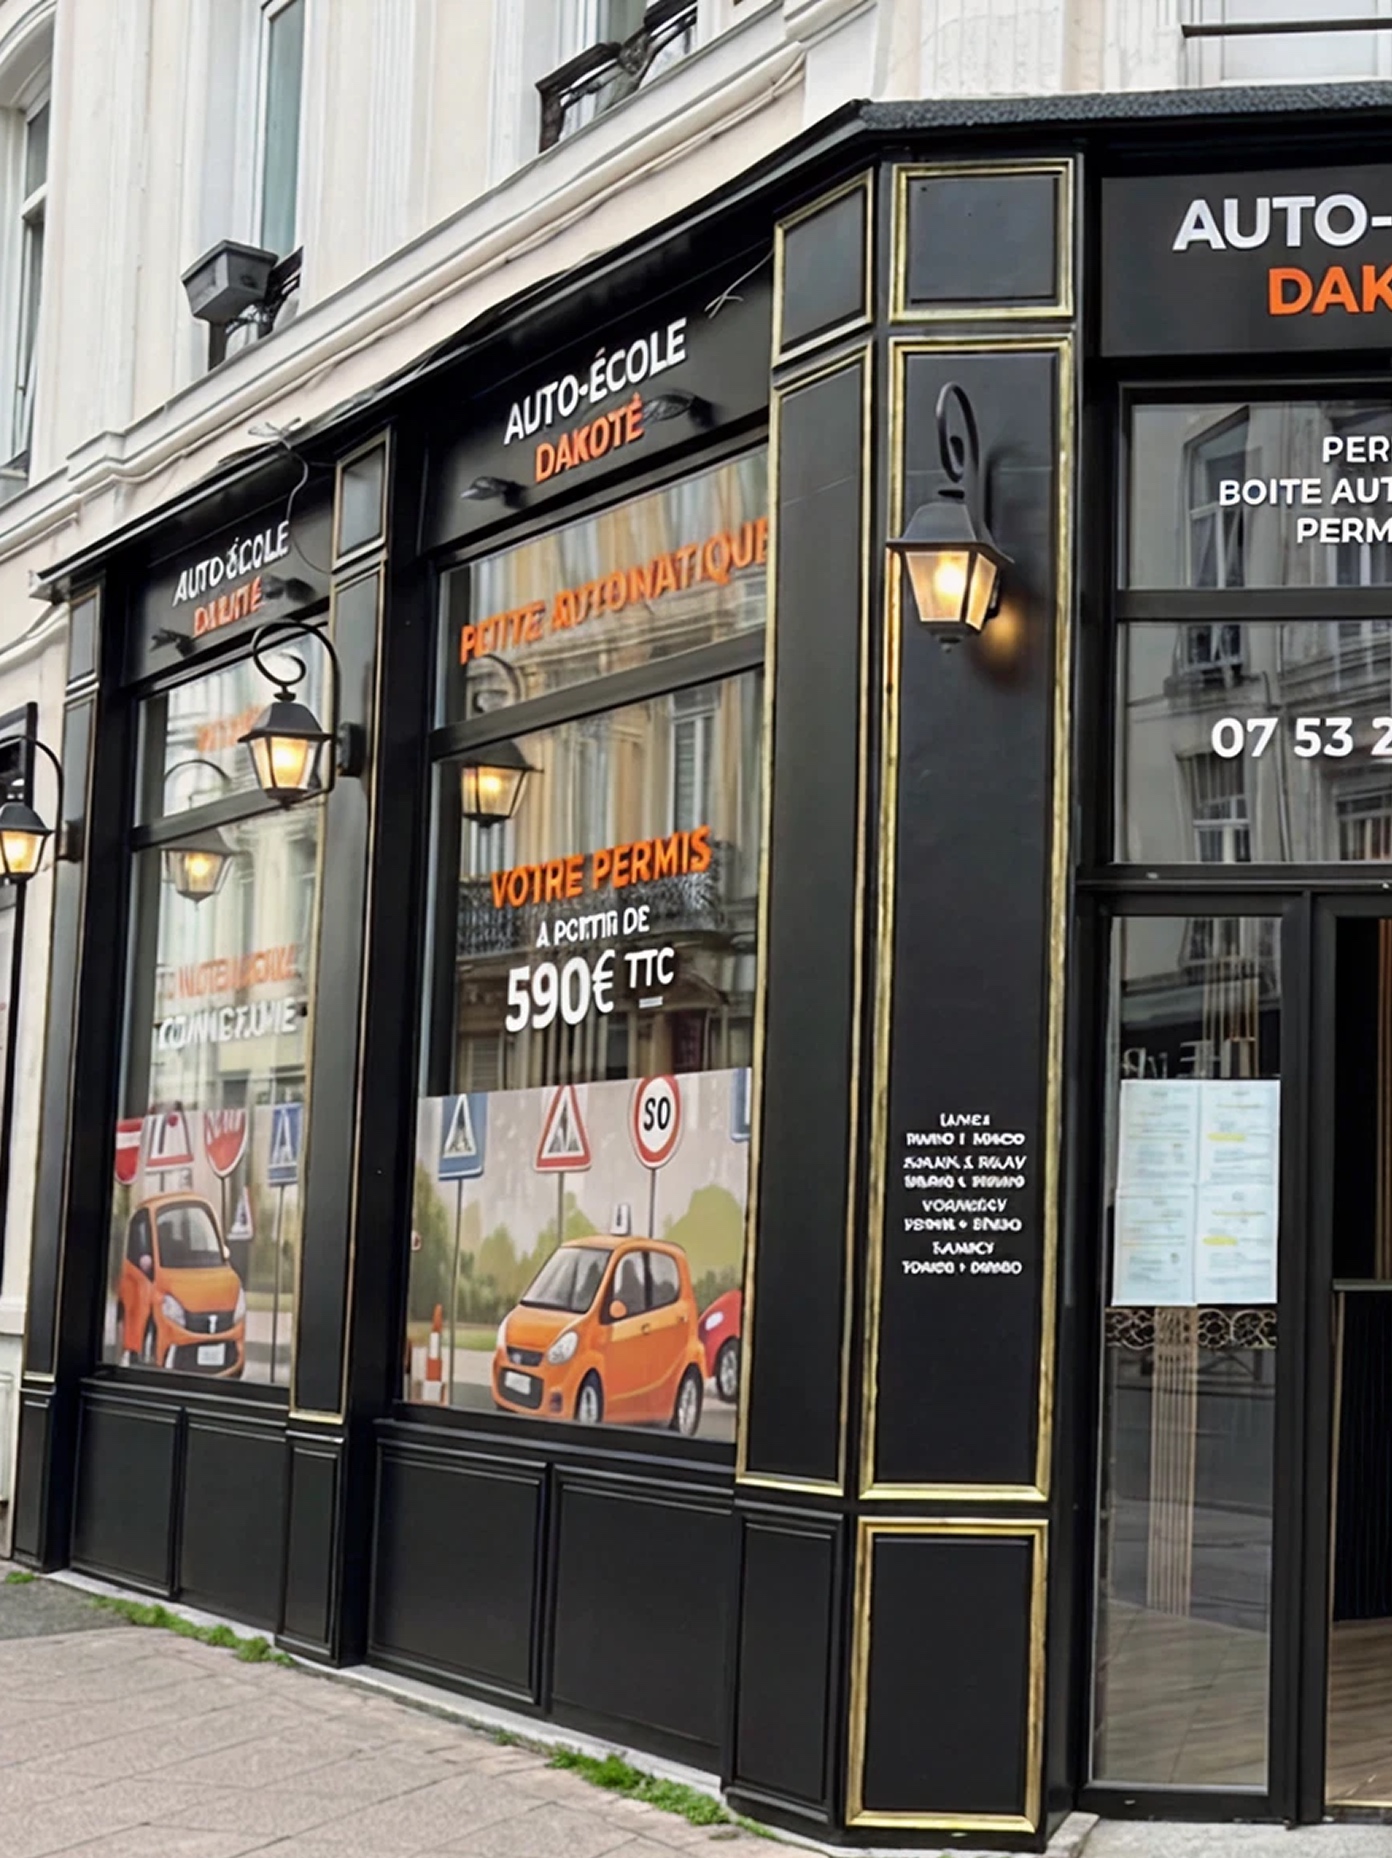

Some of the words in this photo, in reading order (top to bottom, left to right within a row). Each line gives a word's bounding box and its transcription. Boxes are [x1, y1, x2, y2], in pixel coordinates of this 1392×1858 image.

[503, 317, 687, 445] AUTO-ÉCOLE
[534, 392, 644, 483] DAKOTÉ
[1219, 478, 1323, 507] BOITE
[1211, 717, 1278, 758] 07
[1293, 717, 1354, 757] 53
[491, 854, 585, 909] VOTRE
[592, 825, 712, 889] PERMIS
[623, 905, 650, 935] DE
[505, 948, 616, 1032] 590€
[624, 947, 675, 988] TTC
